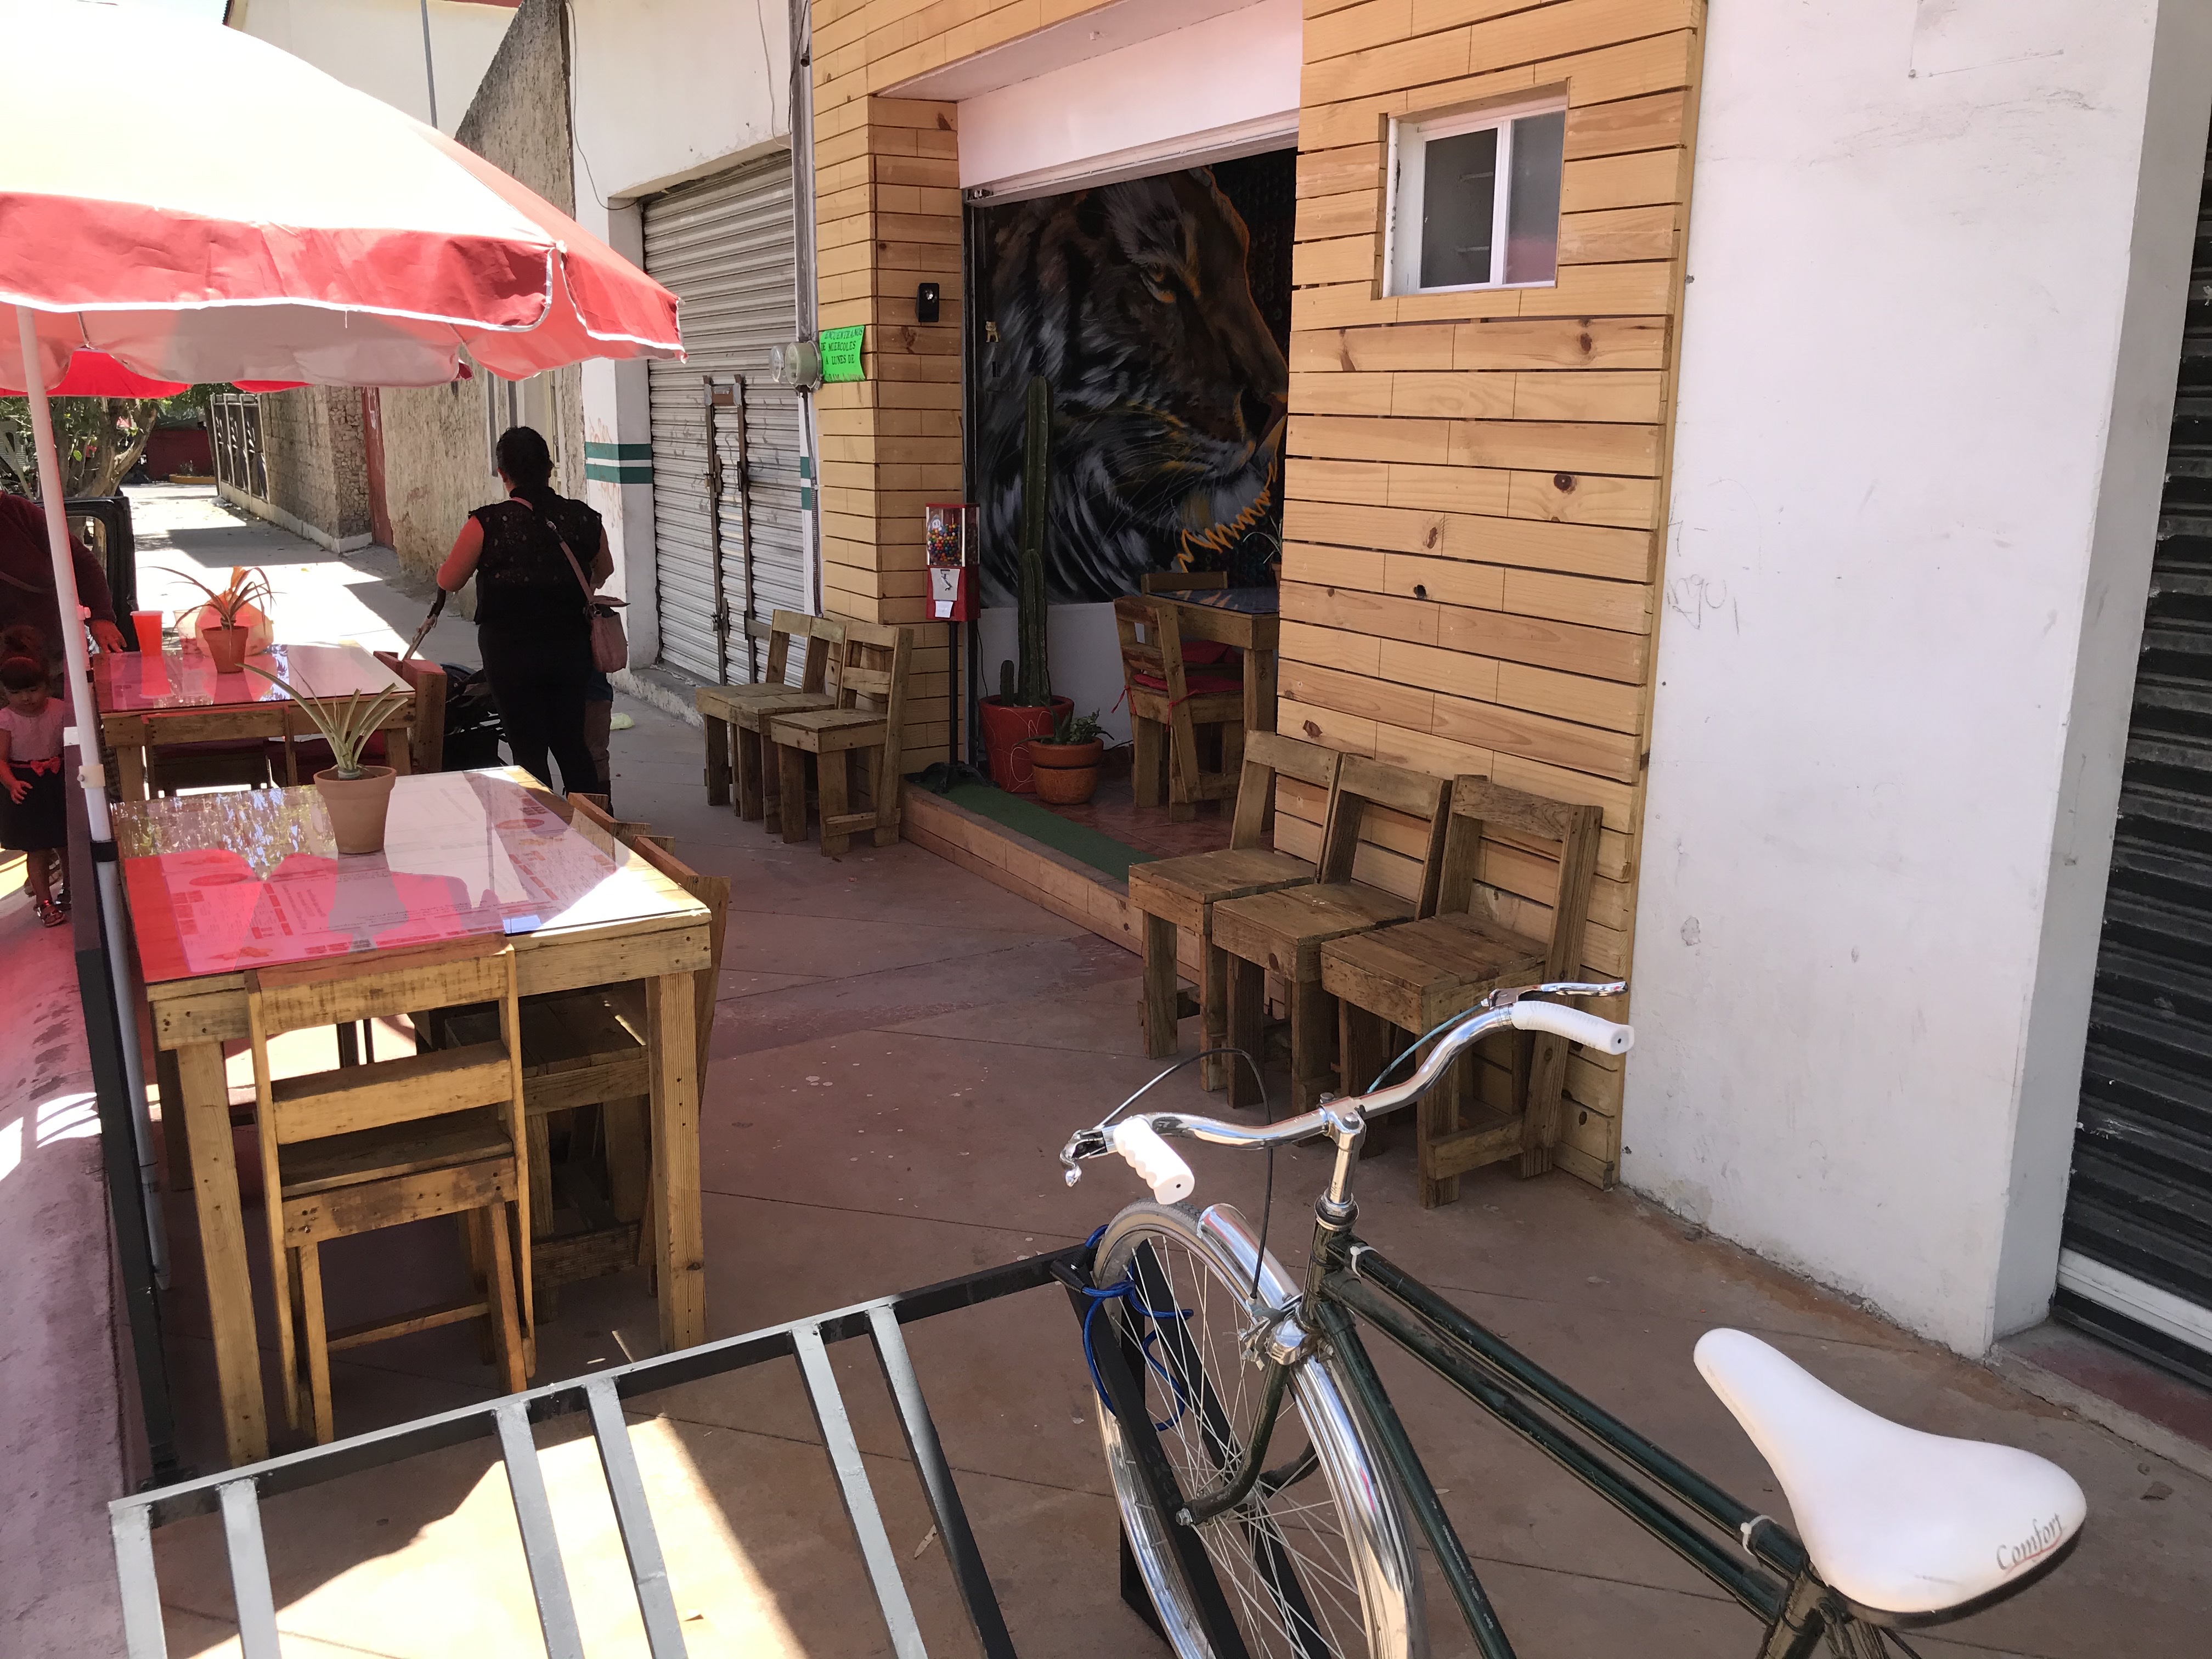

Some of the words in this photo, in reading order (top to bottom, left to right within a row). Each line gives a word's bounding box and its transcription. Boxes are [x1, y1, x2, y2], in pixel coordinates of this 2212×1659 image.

[832, 355, 846, 365] LUNES
[848, 354, 854, 364] DE
[1996, 1513, 2062, 1570] Comfort
